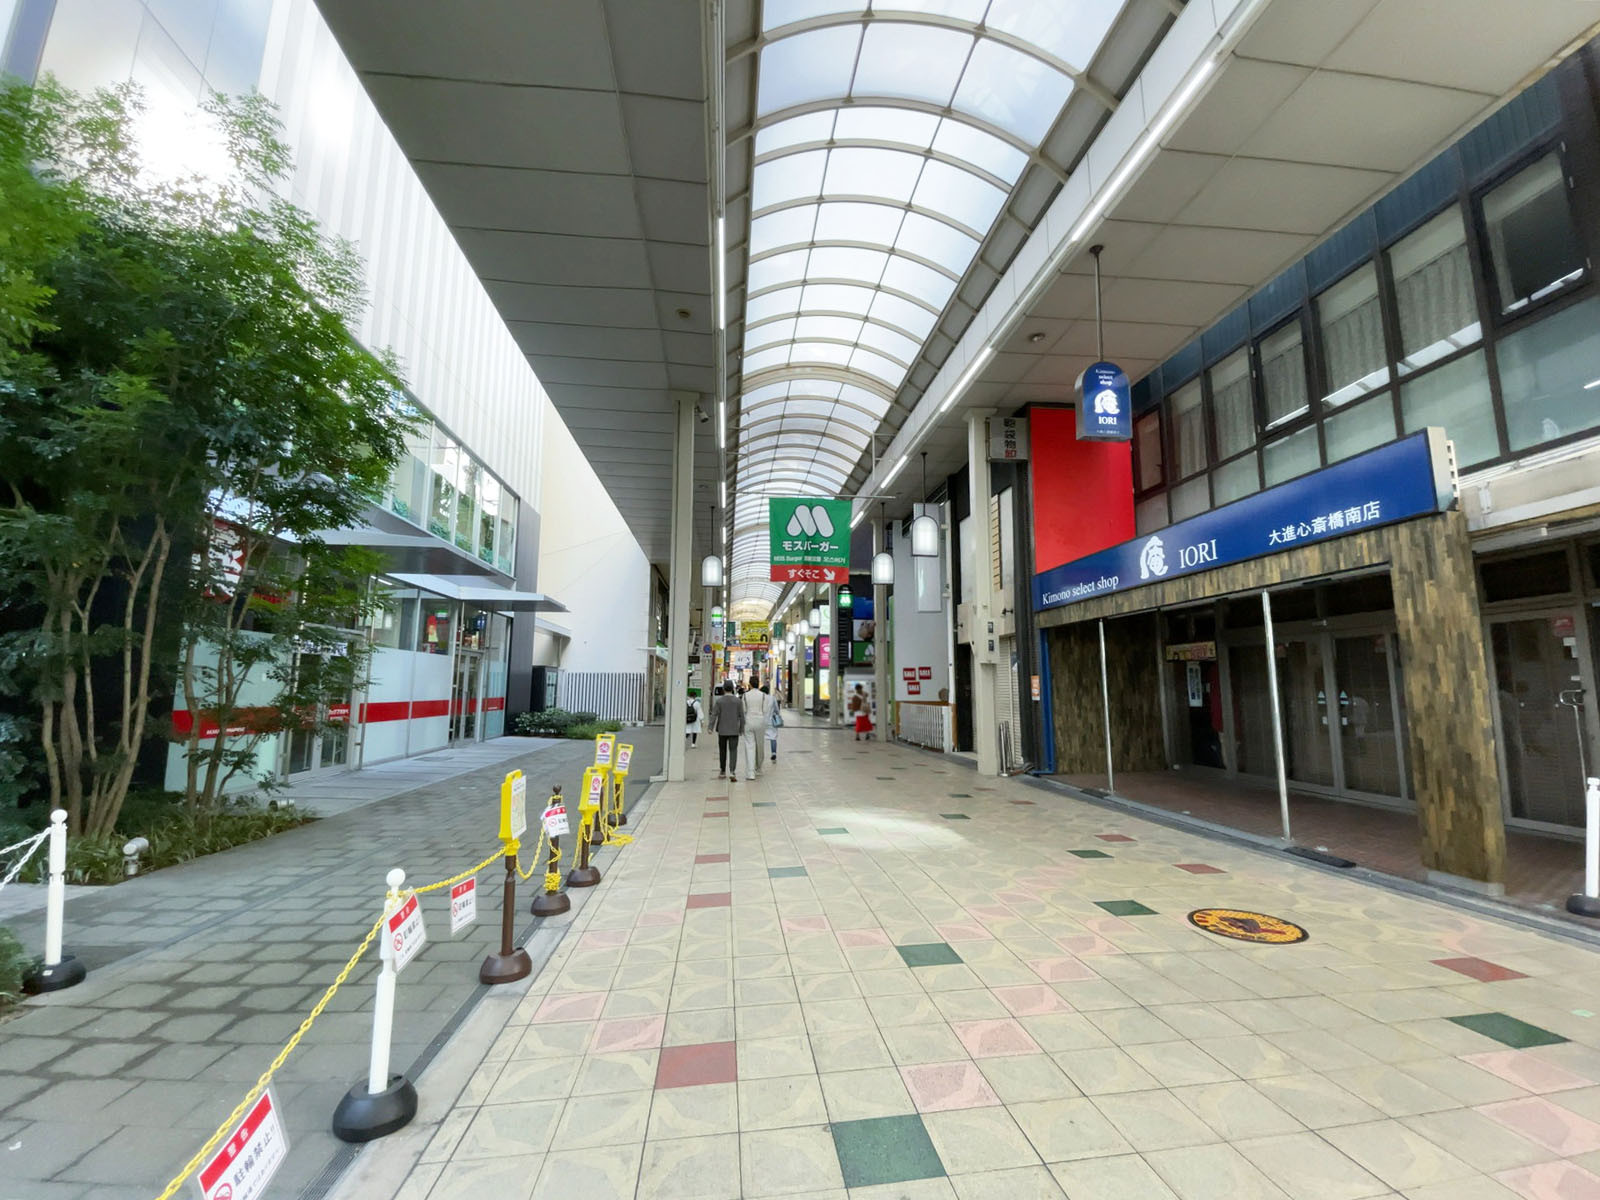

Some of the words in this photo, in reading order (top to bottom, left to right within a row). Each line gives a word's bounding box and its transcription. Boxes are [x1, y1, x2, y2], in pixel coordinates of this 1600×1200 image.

[1098, 416, 1117, 425] IORI
[1268, 500, 1380, 546] 大進心斎橋南店
[782, 540, 839, 552] モスバーガー
[1178, 539, 1219, 569] IORI
[787, 568, 820, 579] すぐそこ
[1042, 591, 1071, 605] Kimono
[1071, 582, 1096, 597] select
[1096, 575, 1119, 592] shop
